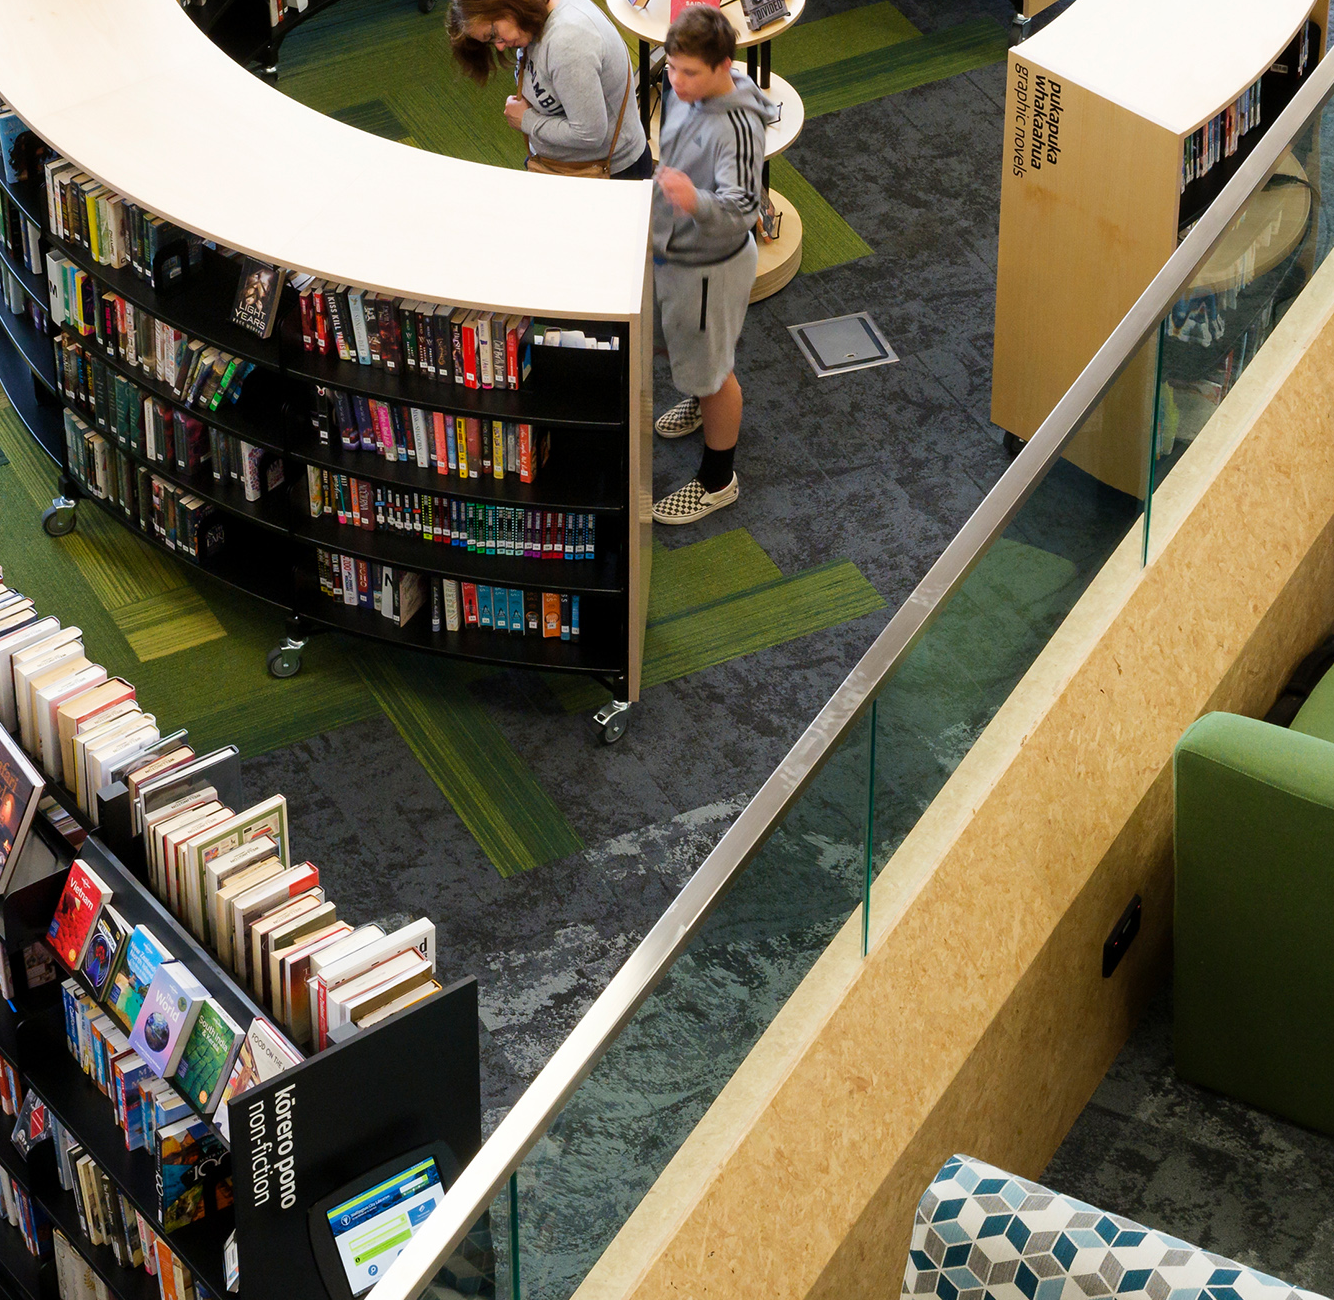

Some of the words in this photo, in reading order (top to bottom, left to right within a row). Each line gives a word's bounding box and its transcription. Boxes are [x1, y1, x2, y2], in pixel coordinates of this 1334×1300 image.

[756, 0, 783, 20] DIVIDED
[1014, 62, 1030, 126] graphic
[1030, 74, 1049, 170] whakaahua
[1045, 79, 1064, 165] pukapuka
[1012, 126, 1027, 179] novels
[48, 280, 58, 298] M
[238, 302, 267, 318] LIGHT
[327, 296, 337, 313] KISS
[233, 309, 266, 330] YEARS
[331, 314, 341, 330] KILL
[145, 757, 175, 774] WELLINGTON
[229, 846, 259, 864] WELLINGTON
[69, 876, 94, 911] Vietnam
[272, 906, 302, 924] WELLINGTON
[130, 941, 140, 954] New
[155, 989, 180, 1023] World
[166, 993, 175, 1005] The
[198, 1015, 216, 1037] South
[215, 1034, 228, 1052] India
[251, 1032, 266, 1051] FOOD
[266, 1048, 275, 1060] ON
[274, 1057, 283, 1070] THE
[274, 1083, 296, 1156] kōrero
[248, 1100, 273, 1207] non-fiction
[273, 1155, 297, 1210] pono
